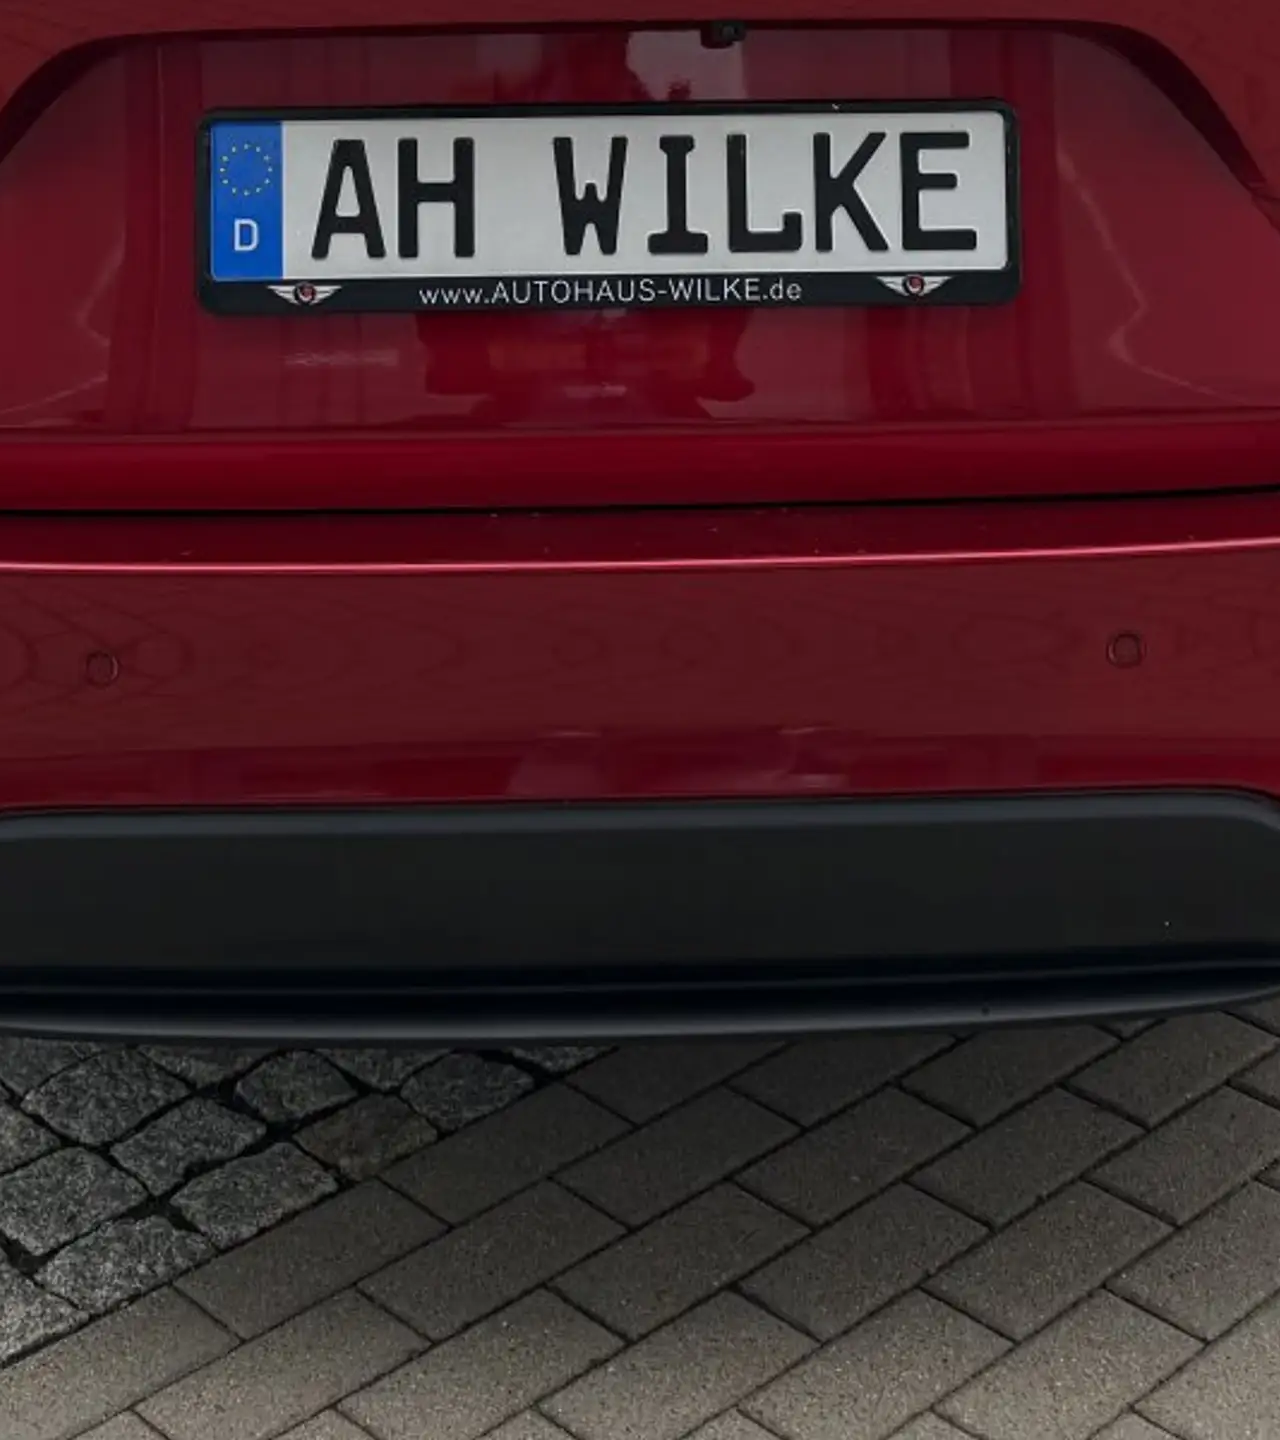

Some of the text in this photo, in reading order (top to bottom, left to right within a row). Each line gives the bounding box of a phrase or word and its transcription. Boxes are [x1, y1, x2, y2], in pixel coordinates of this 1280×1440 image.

[311, 131, 978, 260] AH WILKE
[234, 218, 260, 252] D
[419, 277, 803, 304] www.AUTOHAUS-WILKE.de
